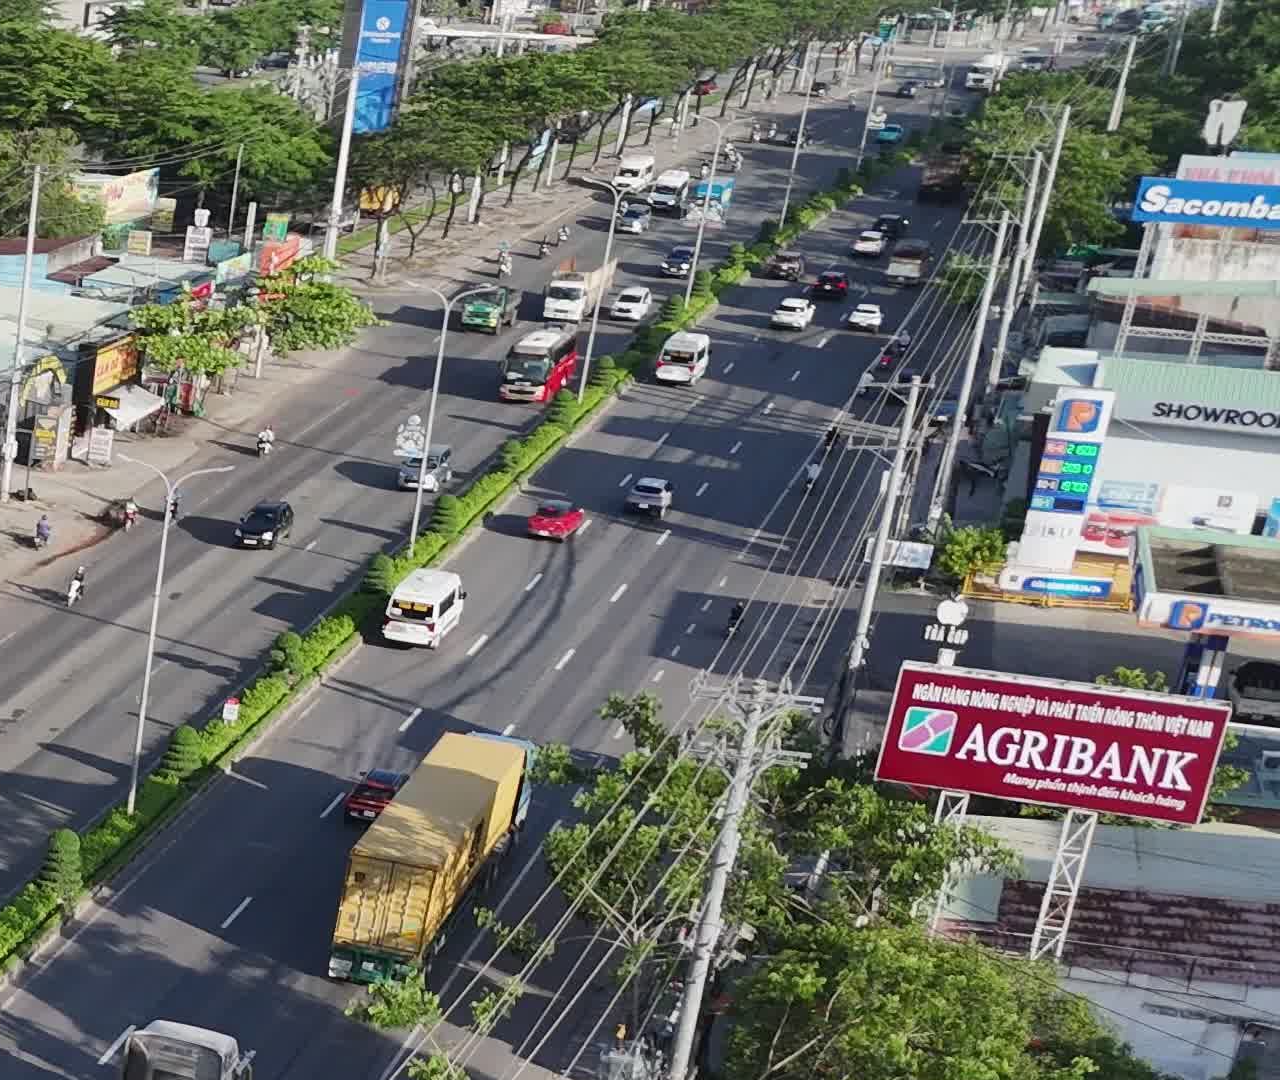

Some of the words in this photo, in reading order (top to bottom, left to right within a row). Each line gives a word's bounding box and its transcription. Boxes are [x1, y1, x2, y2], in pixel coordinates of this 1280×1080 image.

[1152, 402, 1280, 428] SHOWROO
[912, 682, 941, 700] NGÂN
[941, 684, 970, 705] HÀNG
[955, 723, 1198, 793] AGRIBANK
